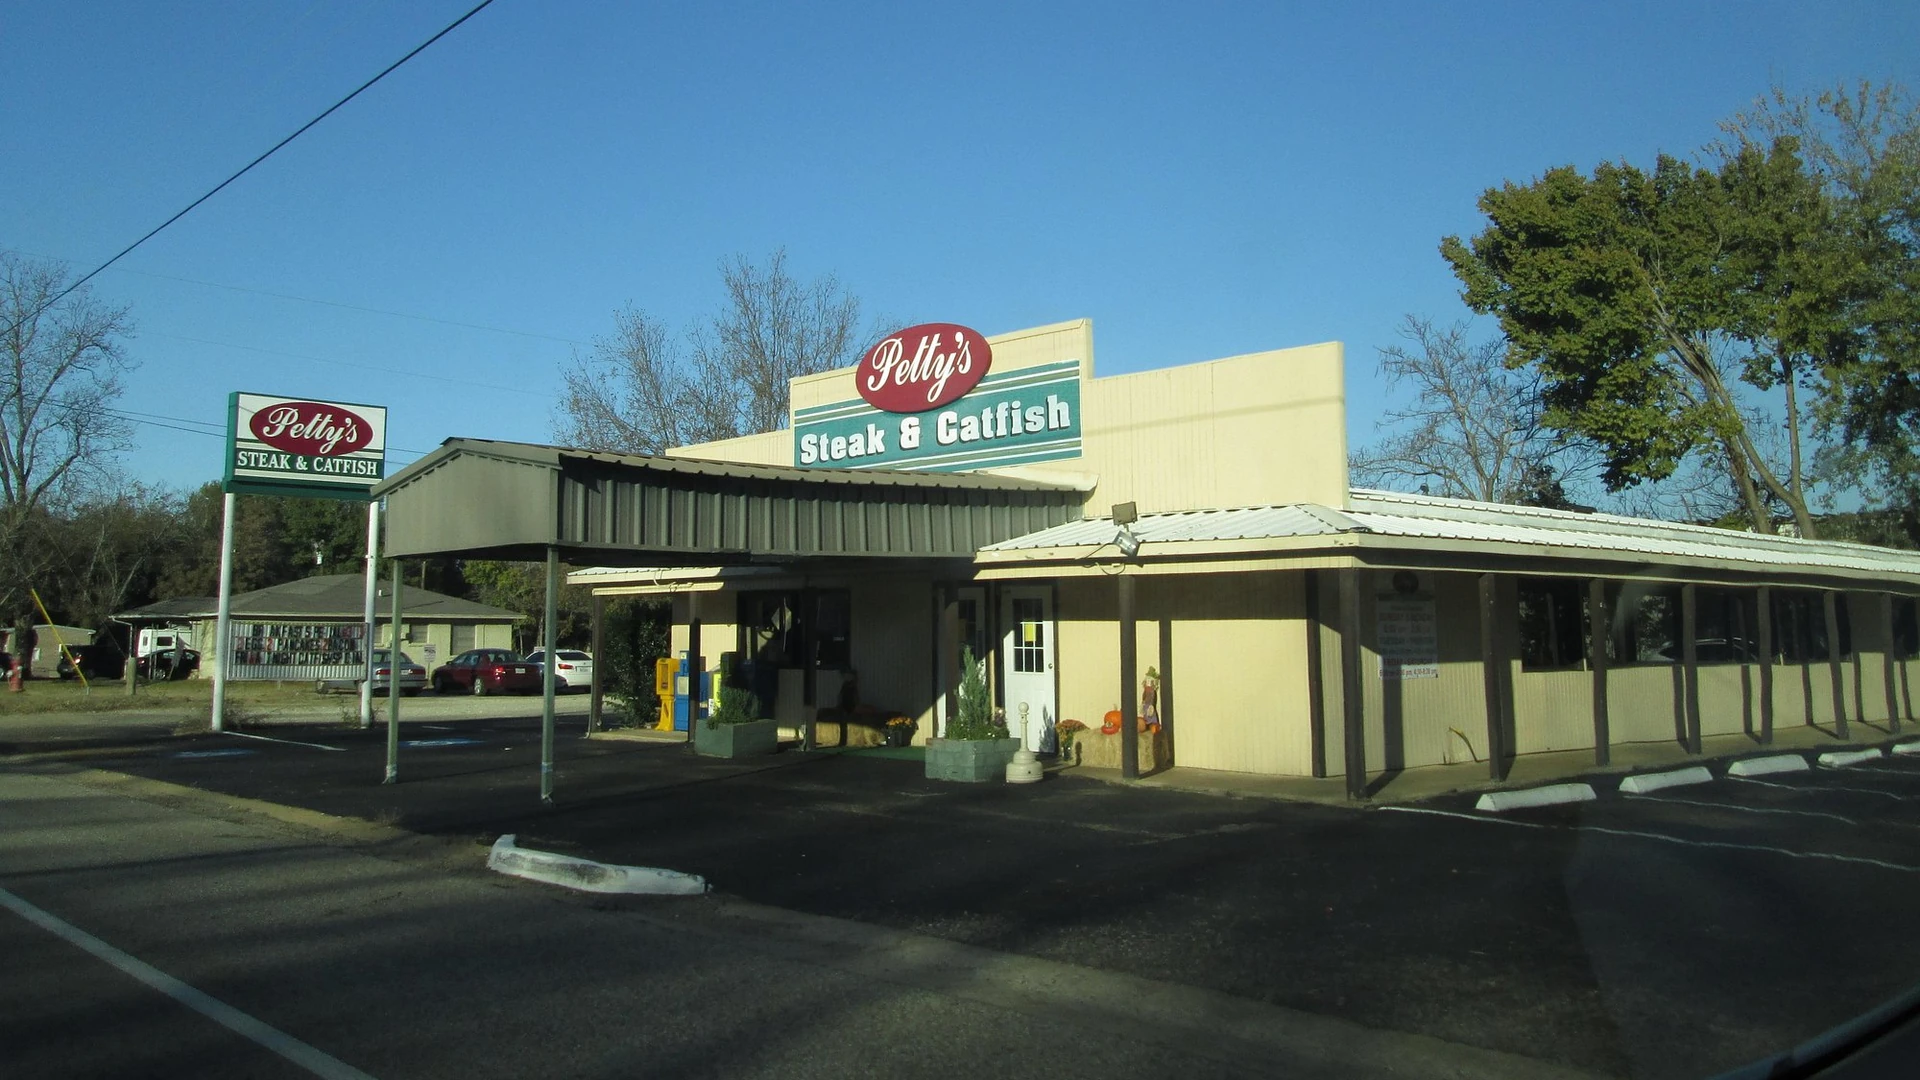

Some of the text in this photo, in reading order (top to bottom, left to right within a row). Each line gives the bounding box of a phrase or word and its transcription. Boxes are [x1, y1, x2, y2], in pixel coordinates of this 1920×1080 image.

[867, 331, 972, 403] Petty's
[262, 407, 358, 454] Petty's
[799, 394, 1071, 465] Steak & Catfish
[237, 450, 378, 476] STEAK & CATFISH
